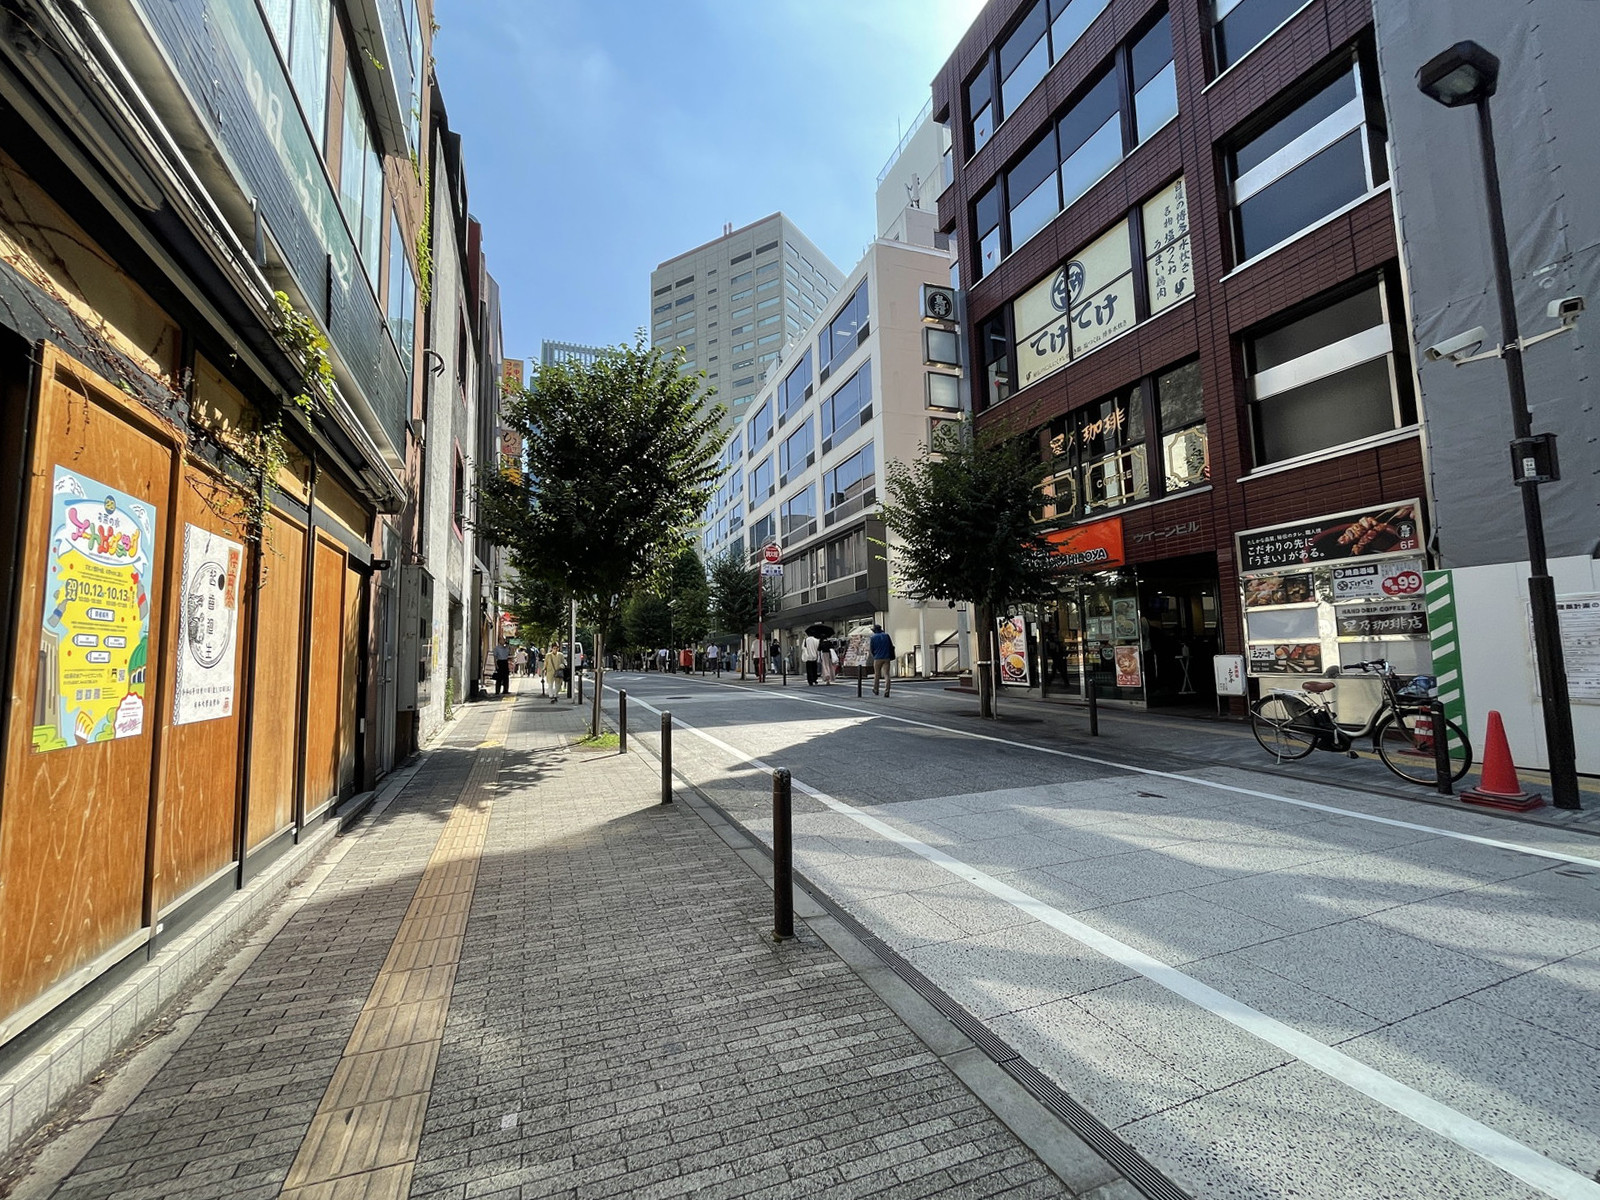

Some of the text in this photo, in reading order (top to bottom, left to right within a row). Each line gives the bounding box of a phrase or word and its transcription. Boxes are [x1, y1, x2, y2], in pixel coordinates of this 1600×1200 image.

[1030, 294, 1118, 356] てけてけ
[1096, 470, 1132, 489] COFFEE
[1248, 537, 1314, 556] こだわりの先に
[1400, 539, 1414, 550] 6F
[1249, 547, 1325, 566] 「うまい」がある。
[1397, 575, 1420, 589] 99
[1380, 604, 1407, 613] COFFEE
[1411, 602, 1422, 611] 2F
[1343, 615, 1424, 633] 星乃珈琲店
